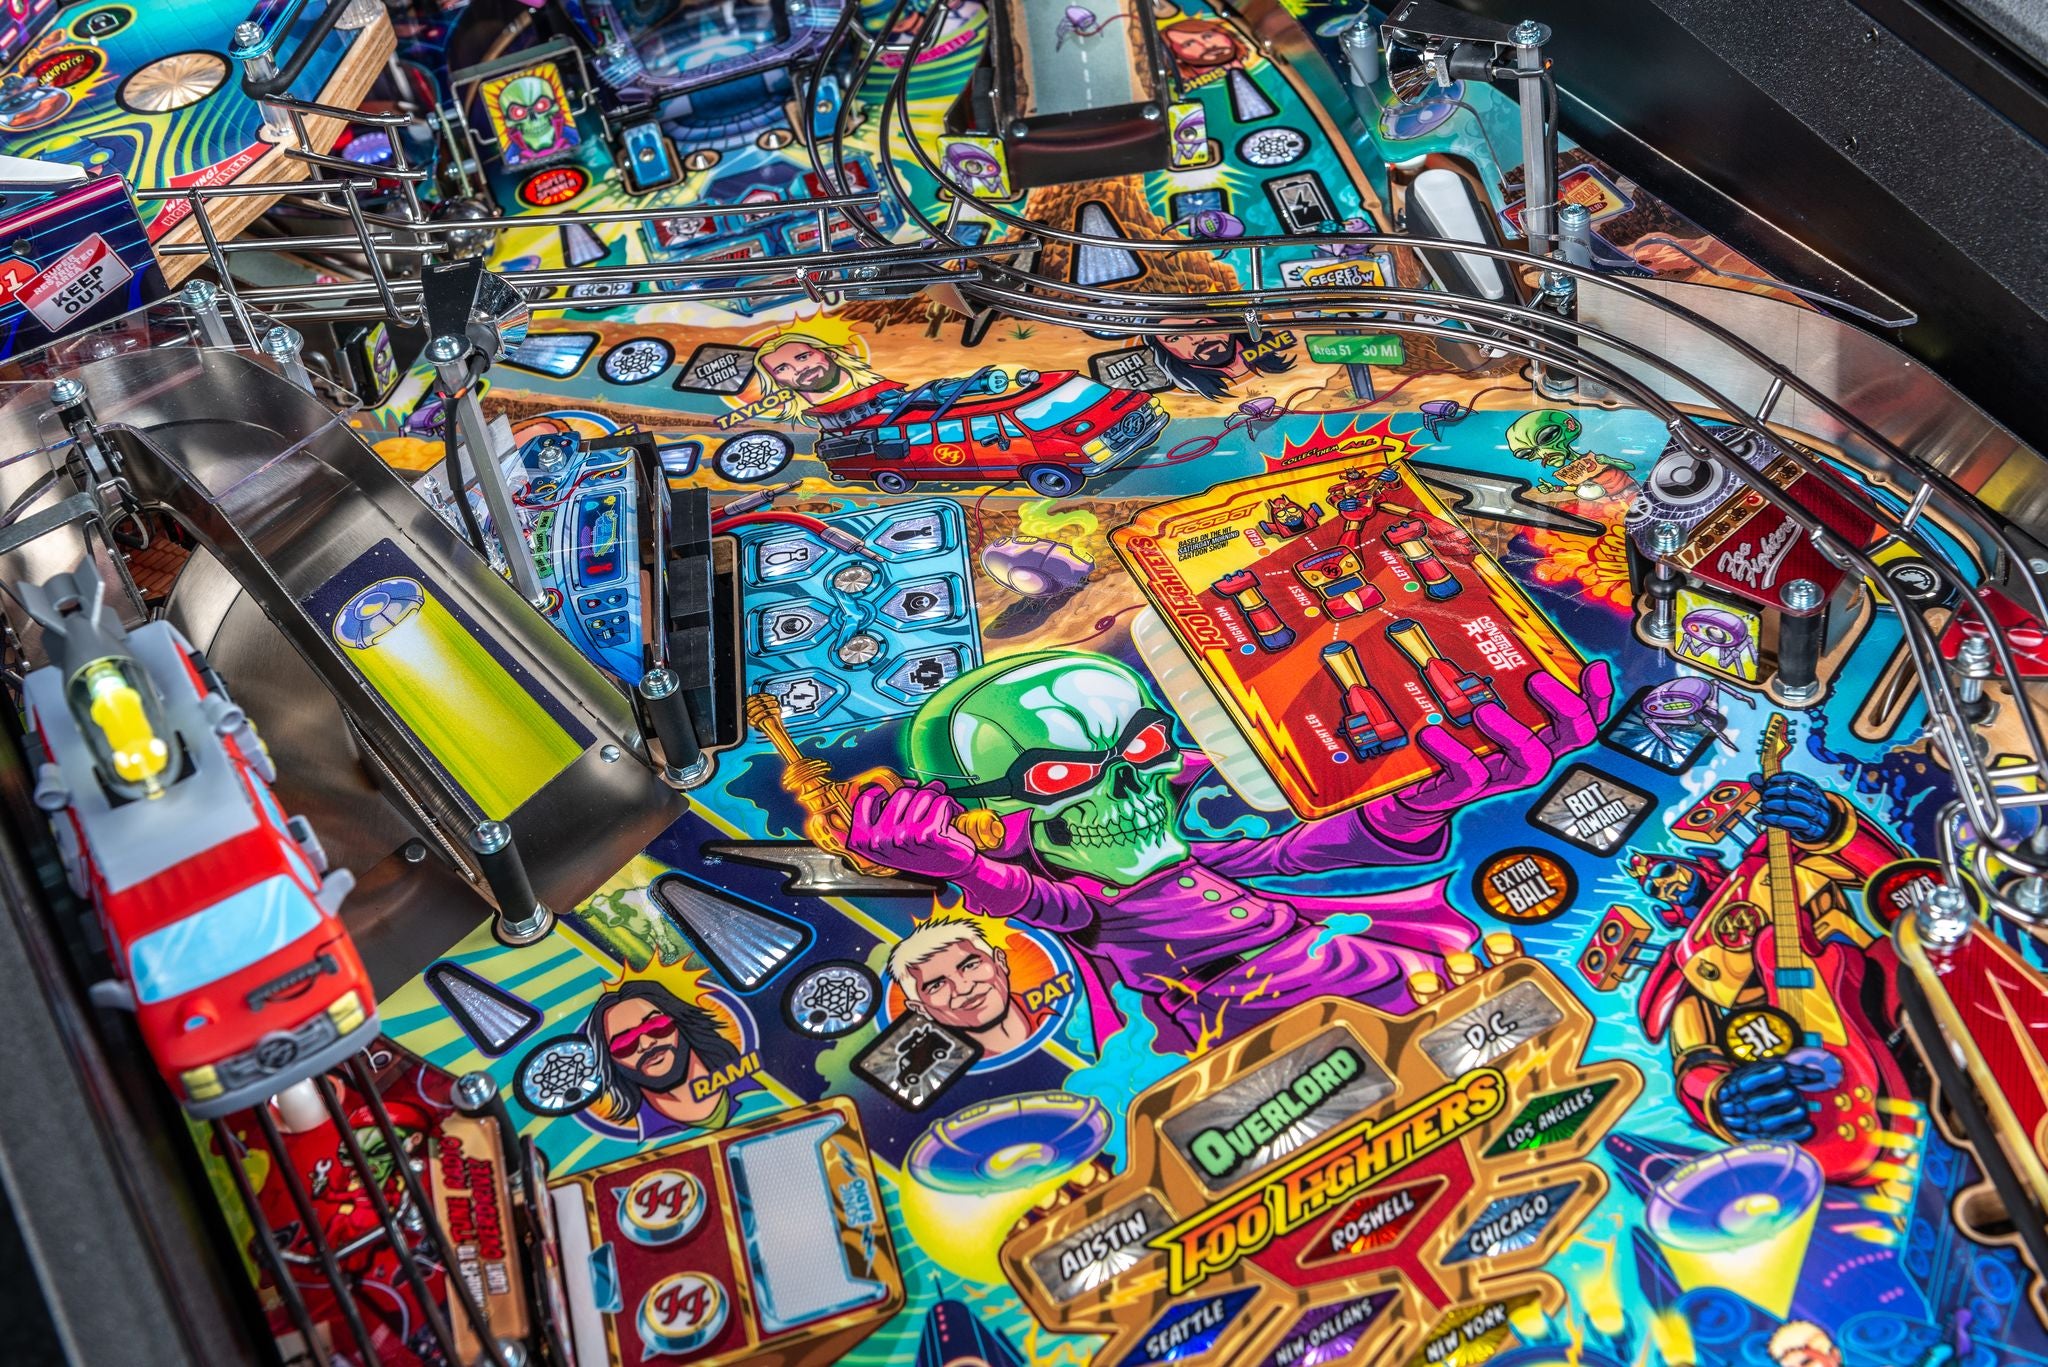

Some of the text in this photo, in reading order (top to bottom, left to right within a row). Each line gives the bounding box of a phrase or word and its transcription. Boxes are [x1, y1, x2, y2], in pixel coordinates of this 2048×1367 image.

[34, 249, 95, 296] RESTRICTED
[43, 254, 76, 281] SUPER
[52, 265, 104, 308] KEEP
[55, 267, 82, 289] AREA
[1310, 264, 1360, 287] SECRET
[65, 281, 105, 314] OUT
[695, 353, 740, 379] COMBO-
[1108, 352, 1145, 380] AREA
[1241, 331, 1293, 363] DAVE
[1313, 344, 1398, 358] Area 51 30 MI
[707, 364, 739, 386] TRON
[1127, 369, 1150, 388] 51
[717, 389, 795, 430] TAYLOR
[1281, 449, 1317, 467] COLLECT
[1316, 444, 1340, 457] THEM
[1169, 501, 1262, 538] FOOBOT
[1178, 526, 1232, 547] BASED ON THE HIT
[1245, 529, 1265, 547] HEAD
[1178, 530, 1240, 556] SATURDAY MORNING
[1178, 541, 1229, 562] CARTOON SHOW!
[1379, 550, 1411, 581] LEFT ARM
[1127, 536, 1232, 660] FOO FIGHTERS
[1288, 585, 1312, 607] CHEST
[1214, 606, 1248, 643] RIGHT ARM
[1477, 615, 1528, 668] CONSTRUCT
[1461, 621, 1514, 672] A-BOT
[1403, 681, 1437, 713] LEFT LEG
[1305, 713, 1341, 751] RIGHT LEG
[1563, 781, 1608, 819] BOT
[1575, 799, 1630, 839] AWARD
[1490, 856, 1542, 894] EXTRA
[1505, 875, 1557, 915] BALL
[1027, 973, 1074, 1012] PAT
[1465, 1011, 1518, 1050] D.C.
[1738, 1017, 1782, 1058] 3X
[693, 1055, 760, 1101] RAMI
[1192, 1046, 1361, 1176] OVERLORD
[1505, 1087, 1595, 1151] LOS ANGELES
[1178, 1076, 1502, 1285] FOO FIGHTERS
[839, 1185, 858, 1228] SONIC
[852, 1177, 877, 1224] RADIO
[1330, 1191, 1416, 1252] ROSWELL
[1468, 1195, 1549, 1254] CHICAGO
[1058, 1210, 1149, 1280] AUSTIN
[1146, 1298, 1225, 1360] SEATTLE
[1275, 1299, 1374, 1367] NEW ORLEANS
[1426, 1304, 1508, 1363] NEW YORK
